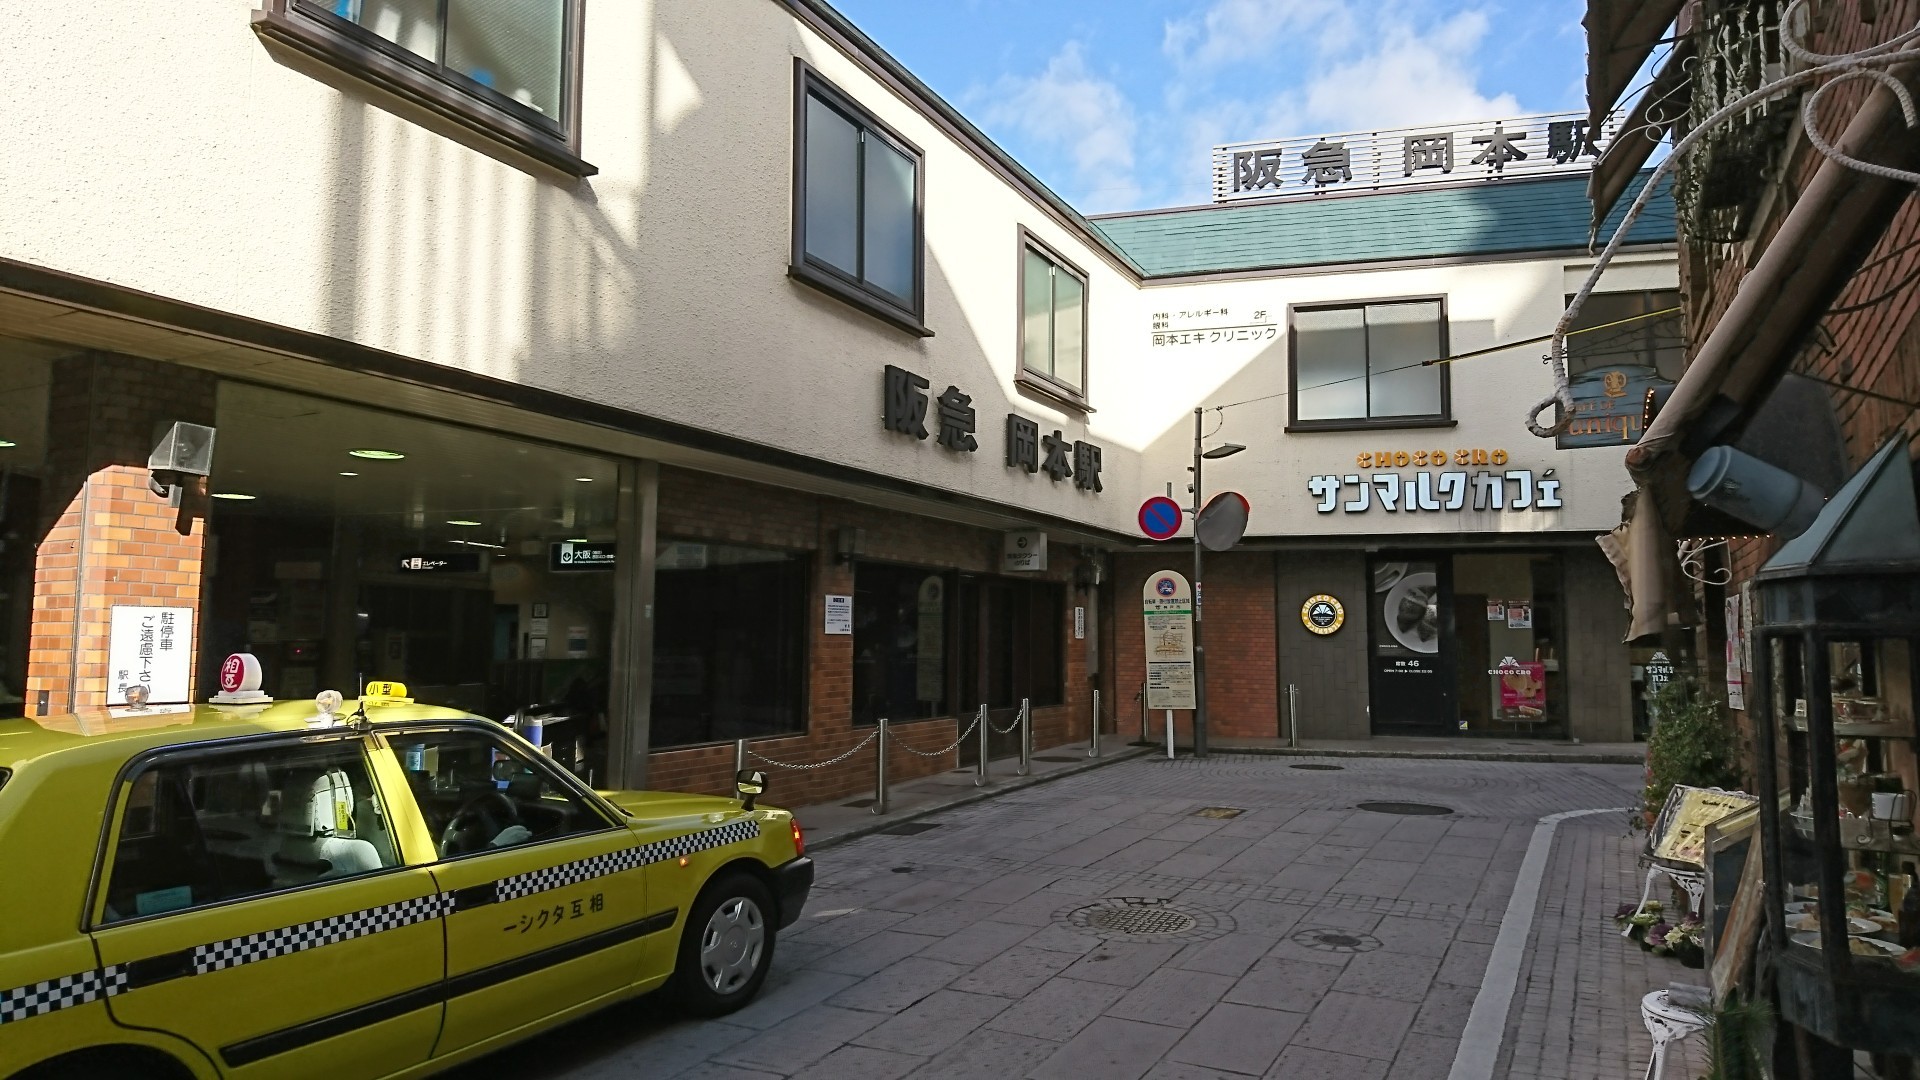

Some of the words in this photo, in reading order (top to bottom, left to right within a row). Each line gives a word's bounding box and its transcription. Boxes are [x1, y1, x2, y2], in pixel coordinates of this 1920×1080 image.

[1233, 140, 1354, 193] 阪急
[1403, 118, 1602, 177] 岡本駅
[1253, 310, 1267, 320] 2F
[884, 364, 979, 452] 阪急
[1006, 412, 1104, 494] 岡本駅
[1355, 449, 1448, 469] CHOCO
[1453, 448, 1509, 466] CRO
[1307, 468, 1563, 513] サンマルクカフェ
[574, 549, 592, 560] 大阪
[159, 611, 176, 651] 駐停車
[223, 657, 240, 689] 相互
[369, 682, 392, 696] 小型
